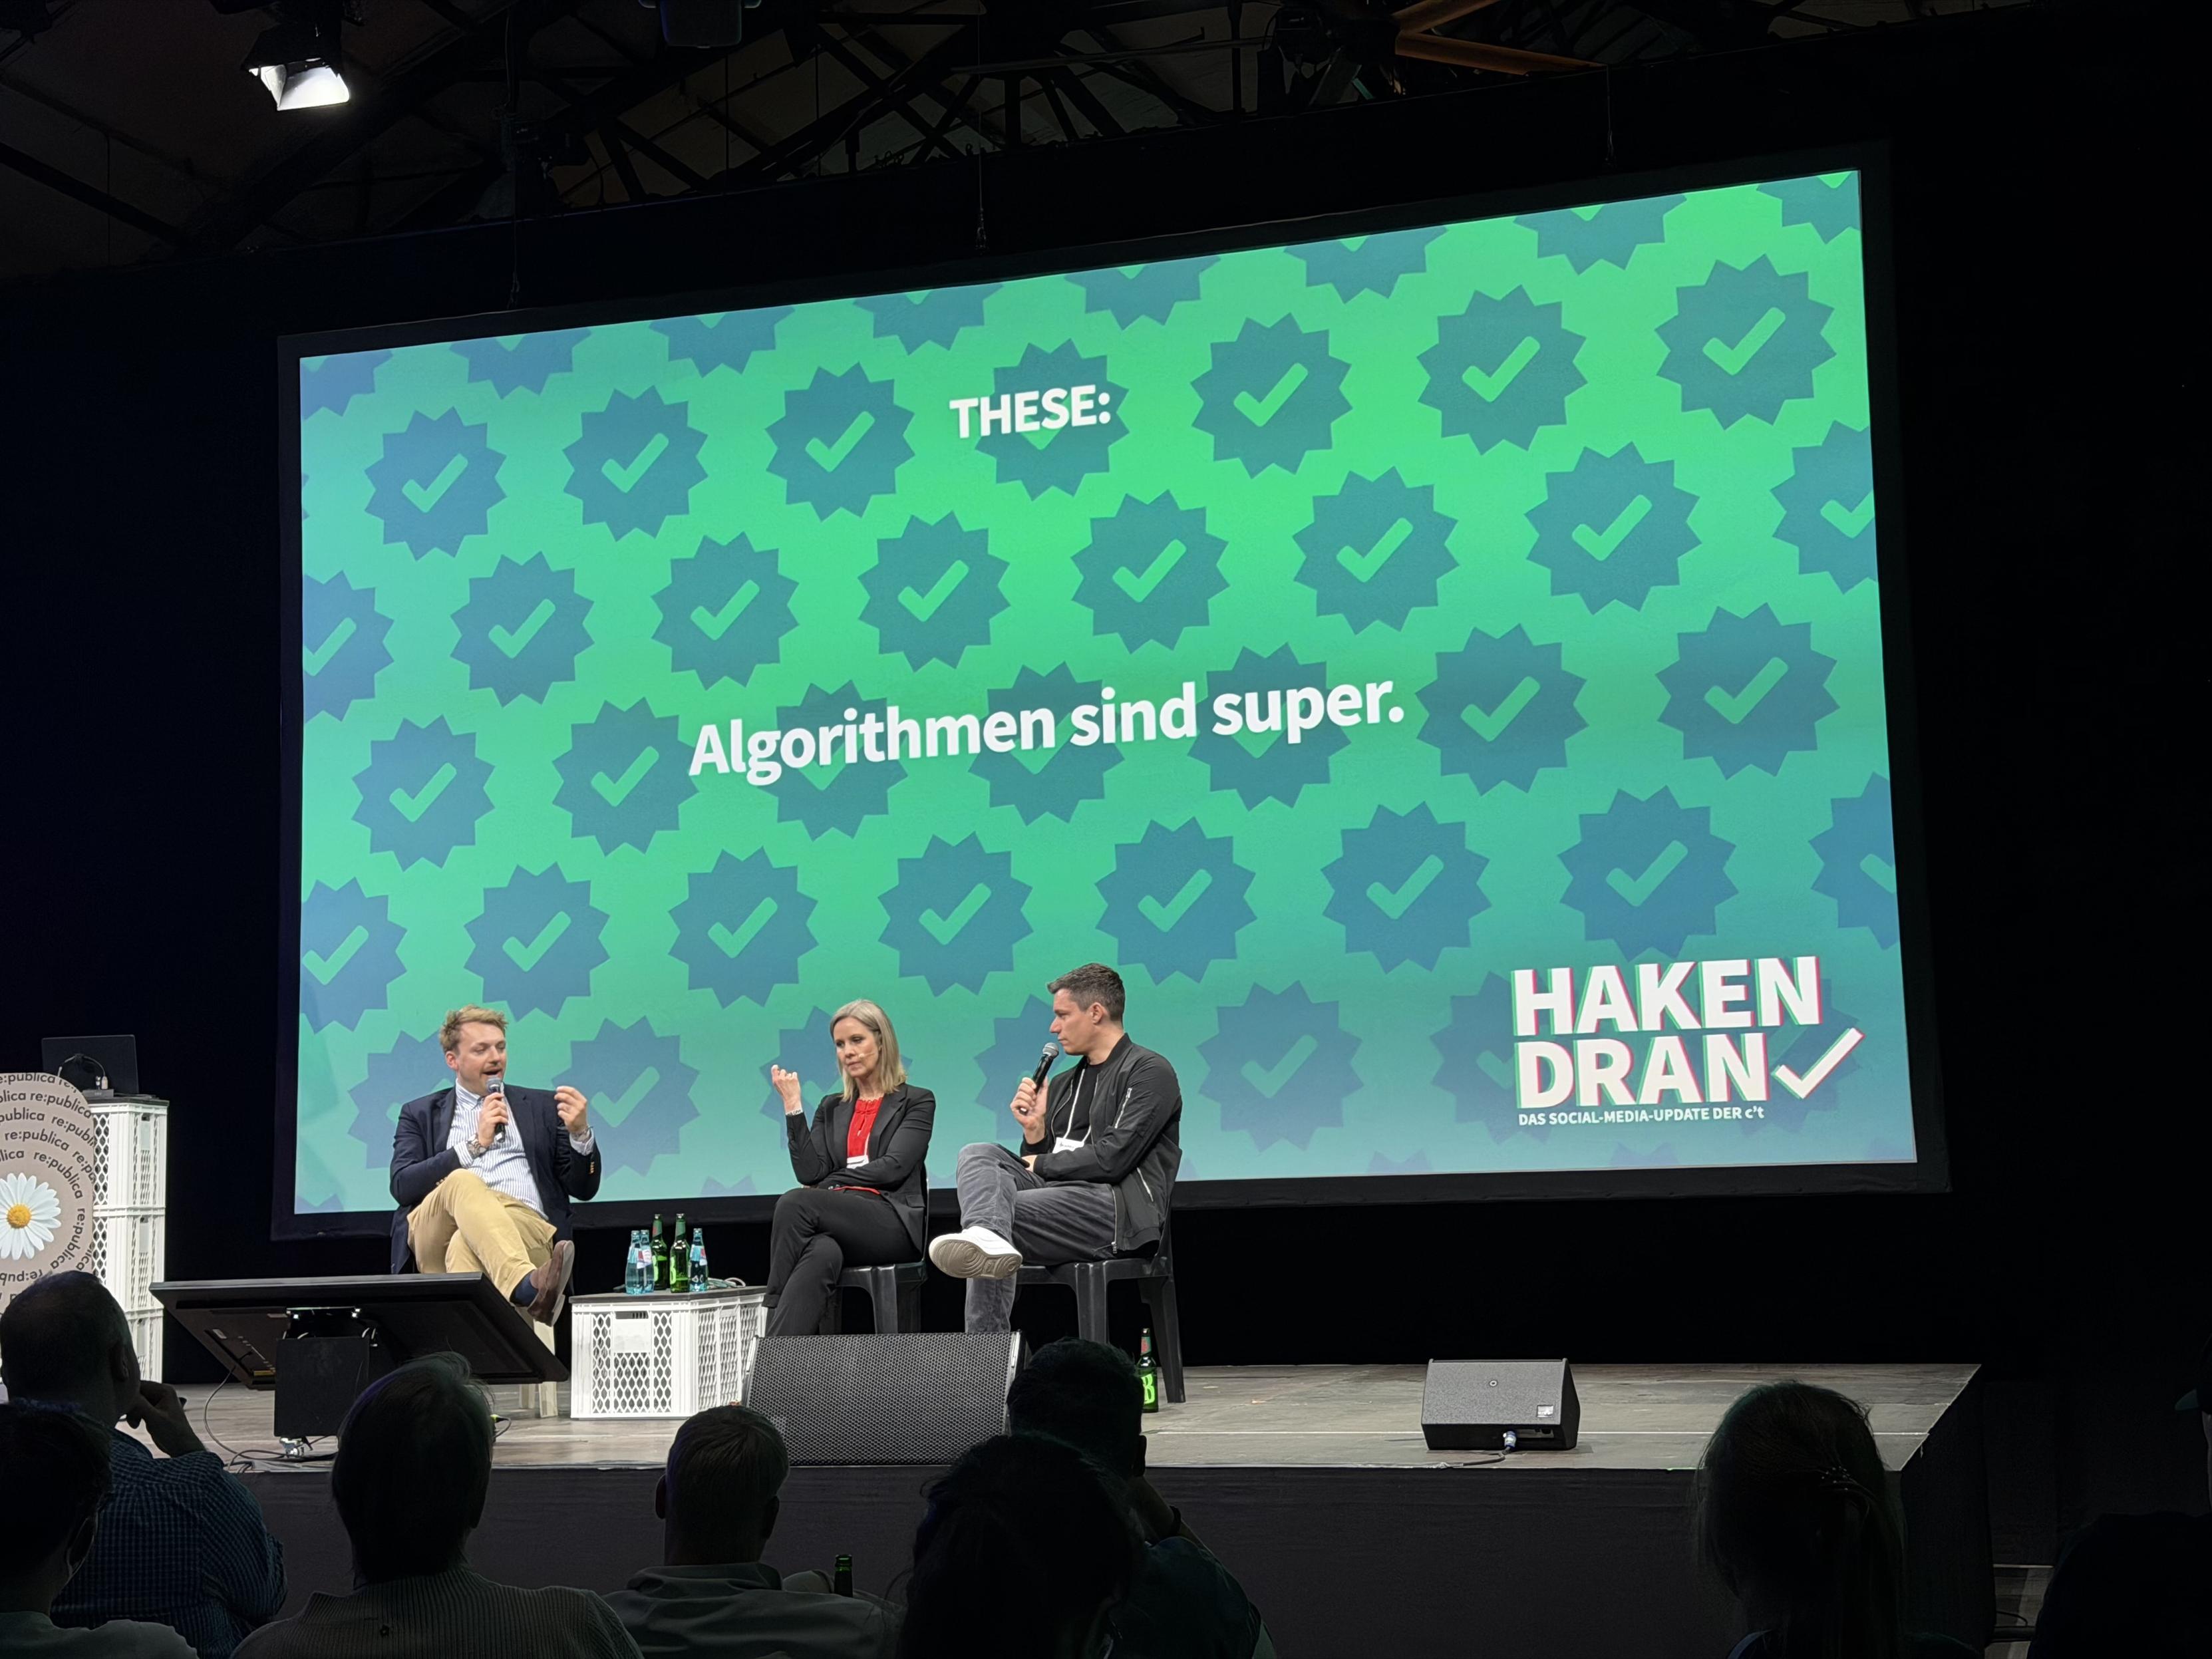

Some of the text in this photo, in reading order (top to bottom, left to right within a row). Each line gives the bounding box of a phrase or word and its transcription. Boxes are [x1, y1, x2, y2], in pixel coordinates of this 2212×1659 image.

[949, 384, 1111, 438] THESE:
[689, 680, 1404, 786] Algorithmen sind super.
[1511, 956, 1822, 1036] HAKEN
[1514, 1032, 1769, 1109] DRAN
[30, 1092, 92, 1118] re:publica
[1518, 1113, 1547, 1126] DAS
[1548, 1108, 1710, 1126] SOCIAL-MEDIA-UPDATE
[1712, 1106, 1742, 1120] DER
[5, 1128, 69, 1151] re:publica
[33, 1151, 83, 1199] re:publica
[50, 1208, 85, 1269] re:publica
